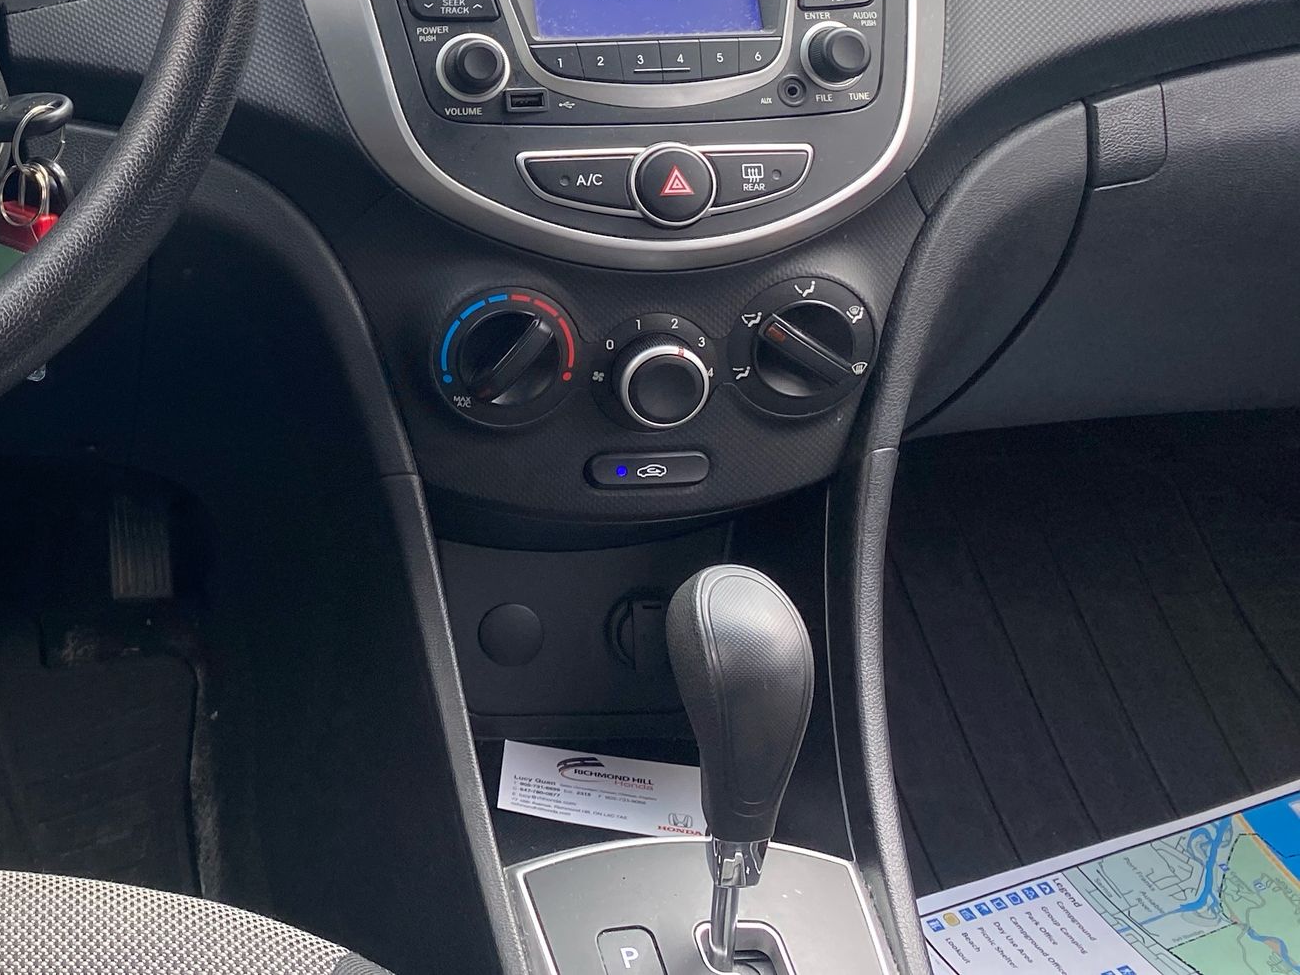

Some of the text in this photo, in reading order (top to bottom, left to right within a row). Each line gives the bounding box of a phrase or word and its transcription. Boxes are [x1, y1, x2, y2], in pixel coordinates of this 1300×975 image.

[440, 6, 470, 15] TRACK
[804, 12, 831, 20] ENTER
[852, 11, 877, 19] AUDIO
[416, 26, 449, 35] POWER
[596, 56, 604, 67] 2
[637, 54, 645, 65] 3
[677, 53, 684, 64] 4
[716, 52, 724, 63] 5
[754, 51, 762, 62] 6
[557, 58, 563, 68] 1
[815, 94, 833, 102] FILE
[848, 92, 870, 101] TUNE
[444, 107, 483, 116] VOLUME
[576, 173, 603, 186] A/C
[743, 183, 765, 192] REAR
[635, 319, 642, 330] 1
[671, 318, 679, 329] 2
[605, 339, 614, 351] 0
[697, 336, 706, 347] 3
[707, 367, 714, 378] 4
[457, 400, 472, 408] A/C
[513, 775, 533, 784] Lucy
[574, 768, 654, 786] RICHMOND HILL
[614, 780, 654, 791] Honda
[657, 825, 703, 836] HONDA
[1053, 878, 1083, 908] Legend
[1056, 901, 1097, 942] Campground
[1025, 911, 1058, 946] Park Office
[1041, 906, 1088, 955] Group Camping
[961, 932, 981, 953] Beach
[977, 926, 1018, 969] Picnic Shelter
[993, 921, 1033, 963] Day Use Area
[1009, 916, 1068, 975] Campground Office
[945, 937, 971, 964] Lookout
